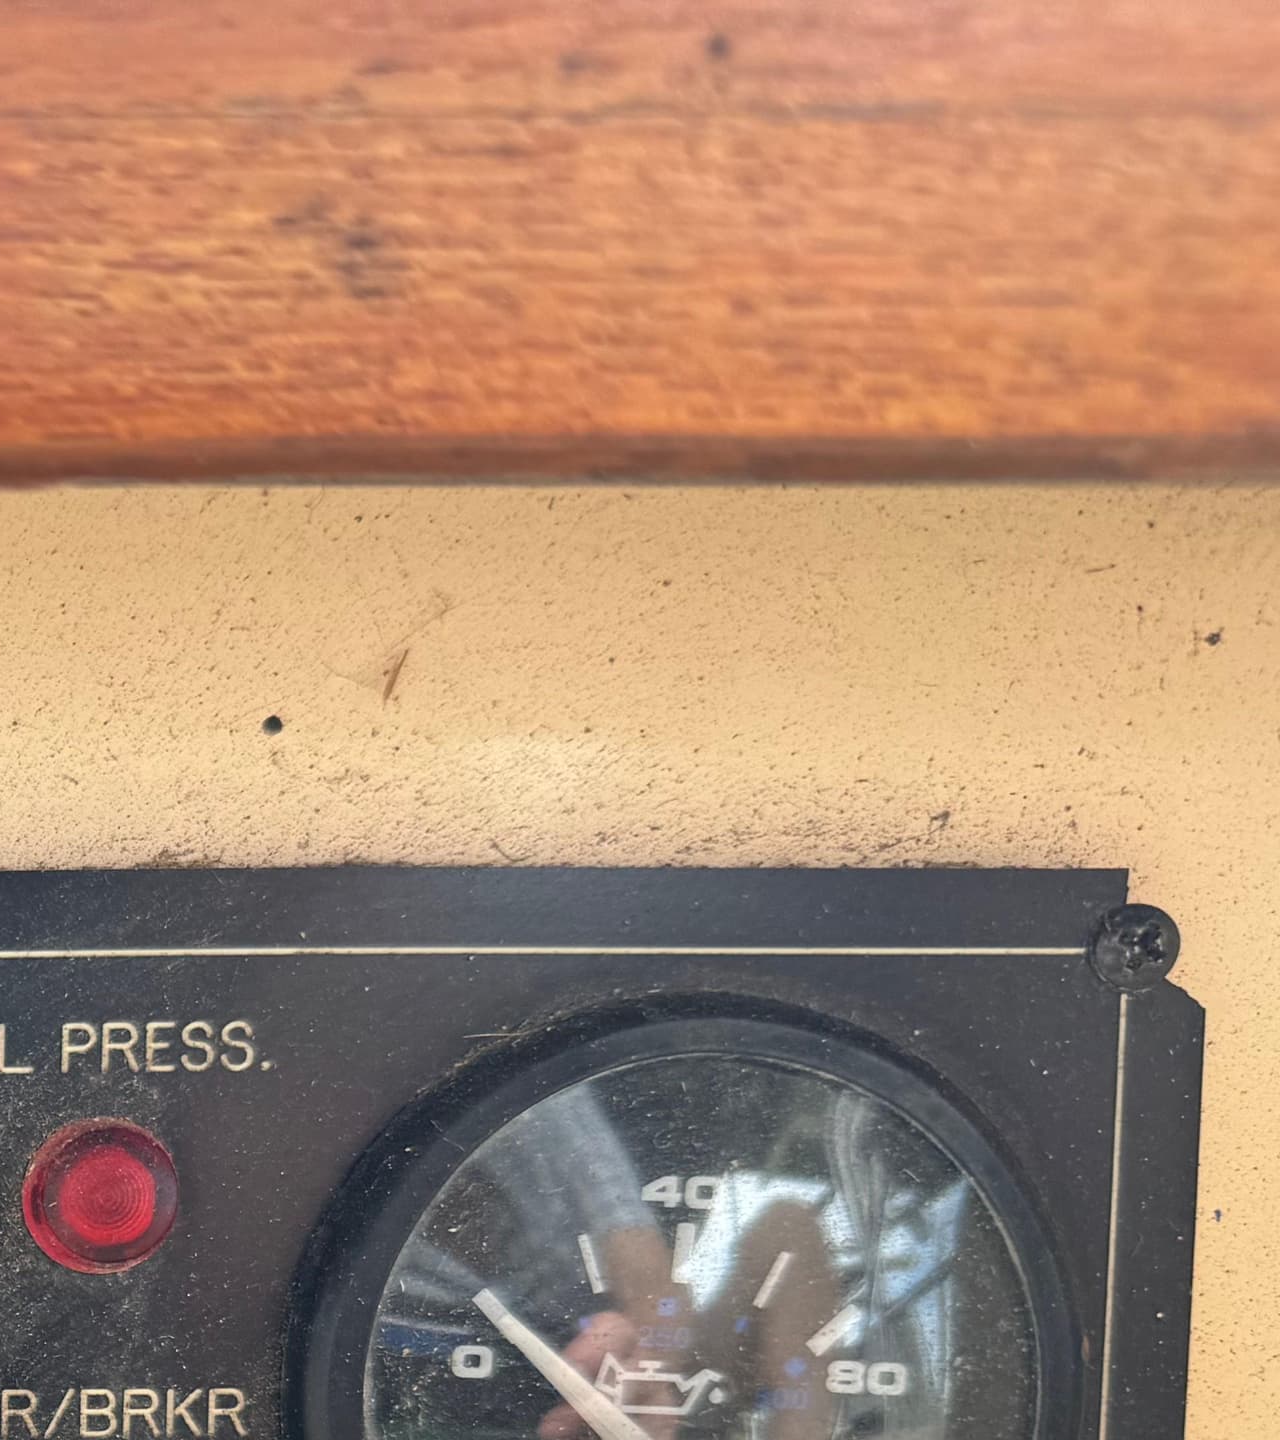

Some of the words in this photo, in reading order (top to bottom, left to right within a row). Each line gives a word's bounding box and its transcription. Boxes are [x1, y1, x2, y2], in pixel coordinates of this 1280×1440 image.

[60, 1020, 274, 1074] PRESS.
[640, 1174, 723, 1210] 40
[451, 1344, 495, 1379] 0
[825, 1360, 908, 1396] 80
